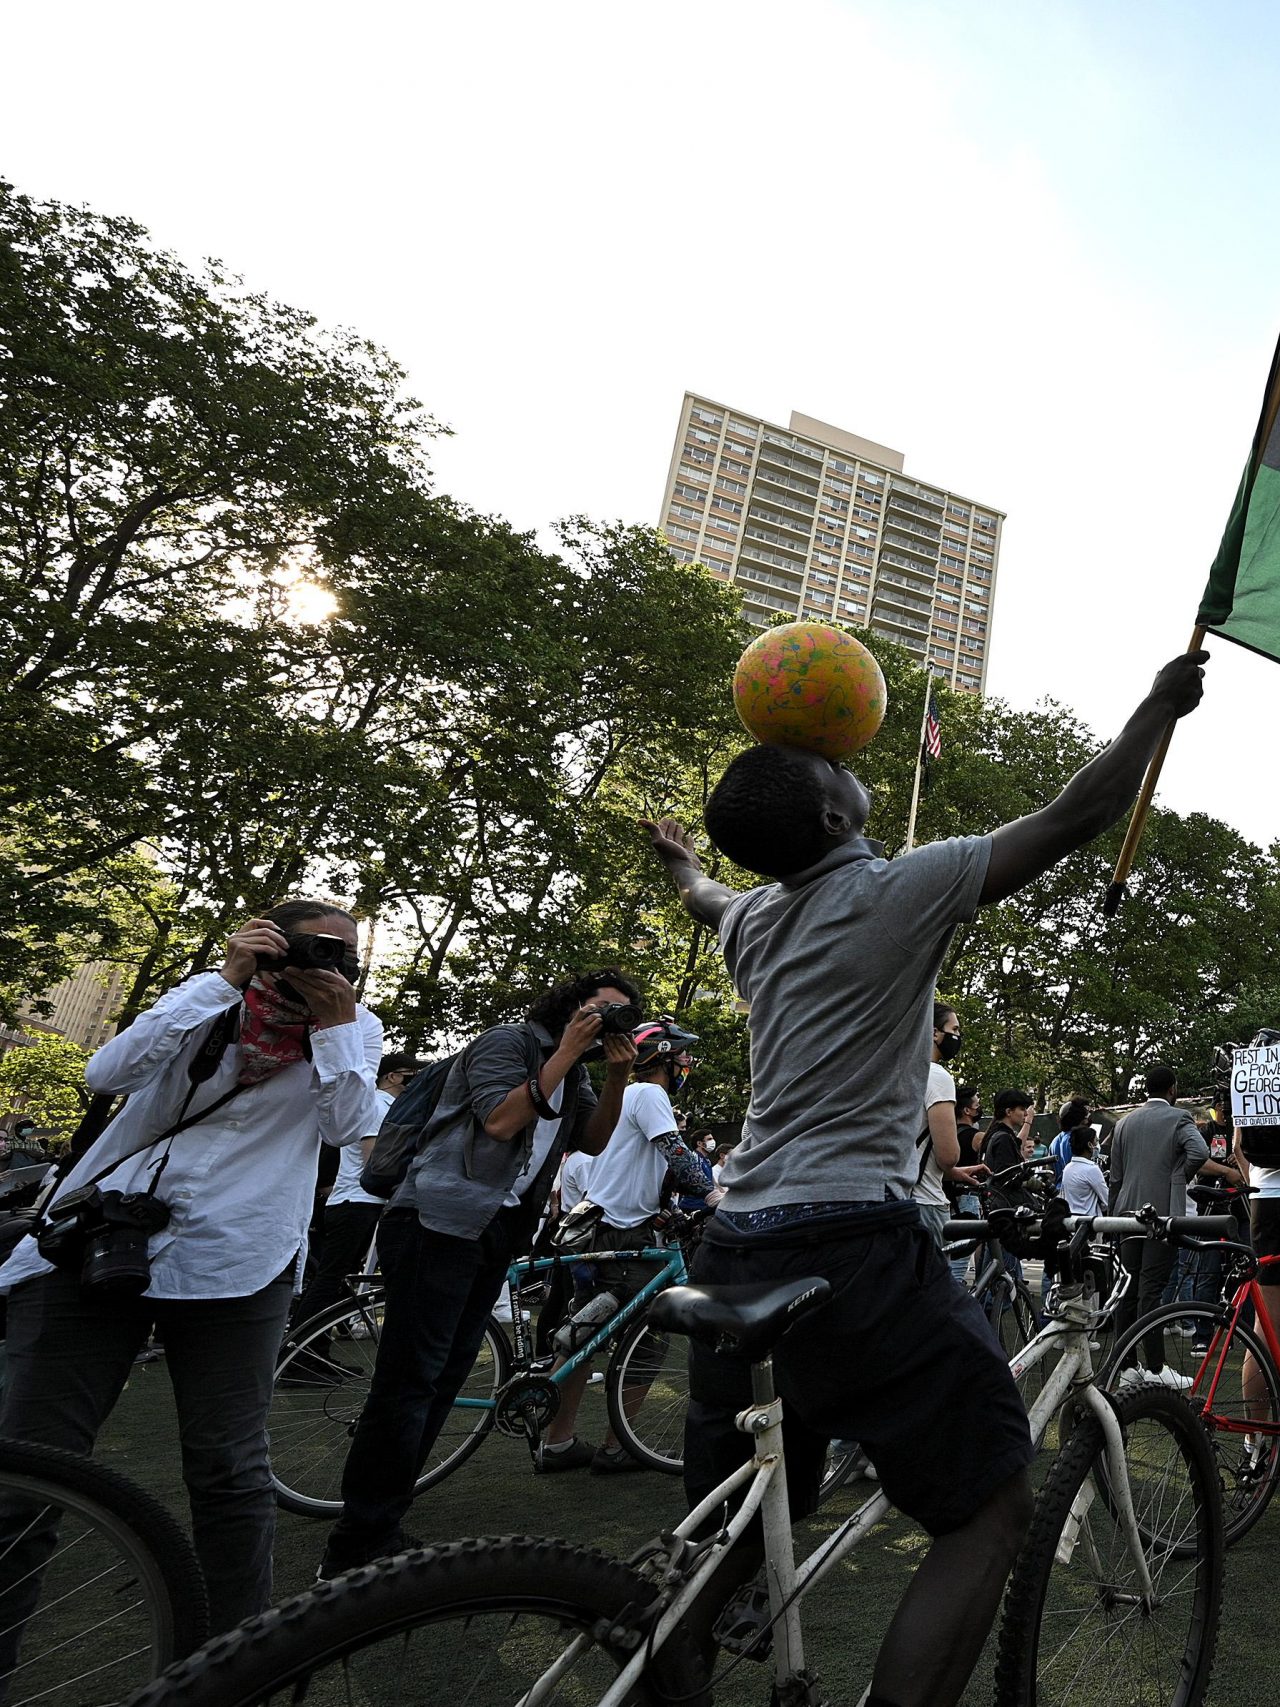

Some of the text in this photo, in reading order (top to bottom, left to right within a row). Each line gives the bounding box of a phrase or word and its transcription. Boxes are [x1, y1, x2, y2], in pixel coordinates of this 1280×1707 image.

[1234, 1048, 1279, 1066] REST IN
[788, 1286, 818, 1312] KENT
[516, 1324, 522, 1335] be
[572, 1291, 646, 1369] RALEIGH
[516, 1336, 525, 1359] riding
